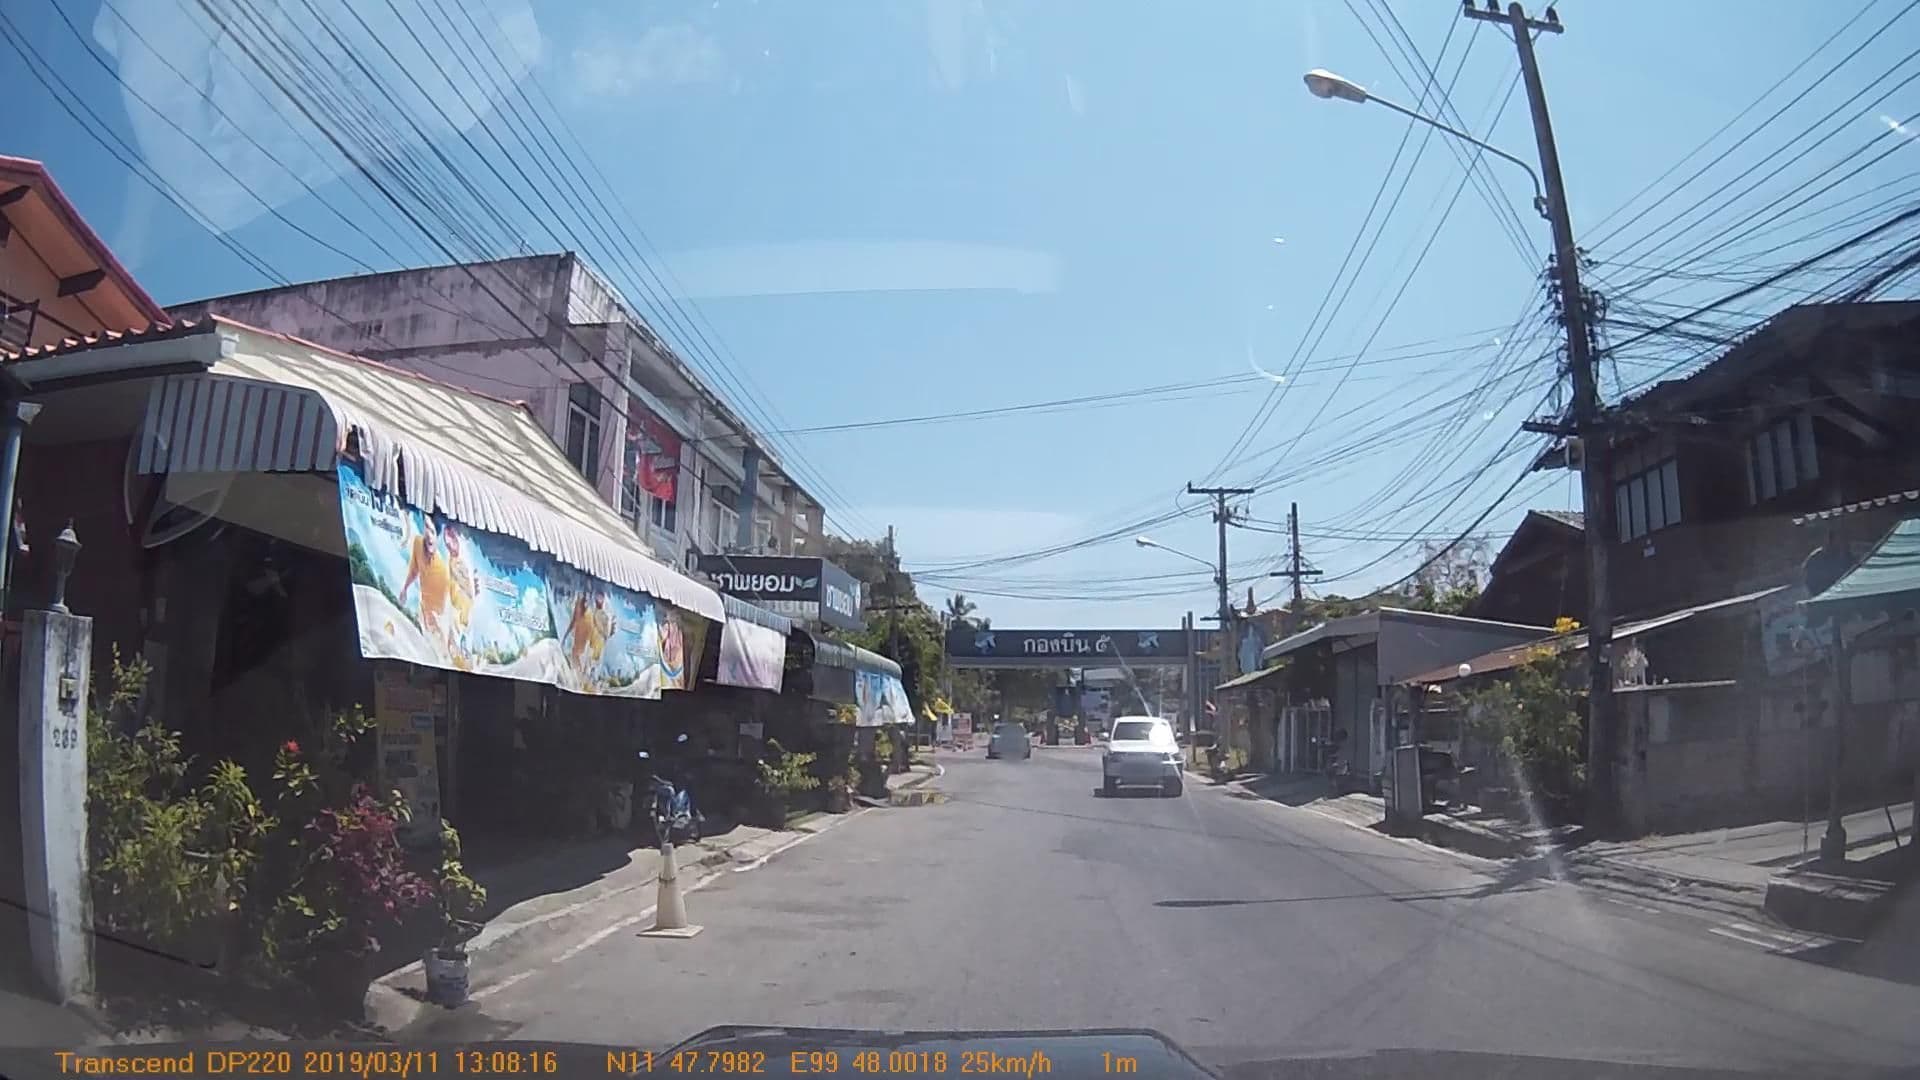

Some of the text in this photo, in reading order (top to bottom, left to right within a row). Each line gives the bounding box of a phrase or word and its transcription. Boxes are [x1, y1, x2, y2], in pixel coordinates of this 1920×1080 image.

[1023, 631, 1111, 653] กองบิน ๕
